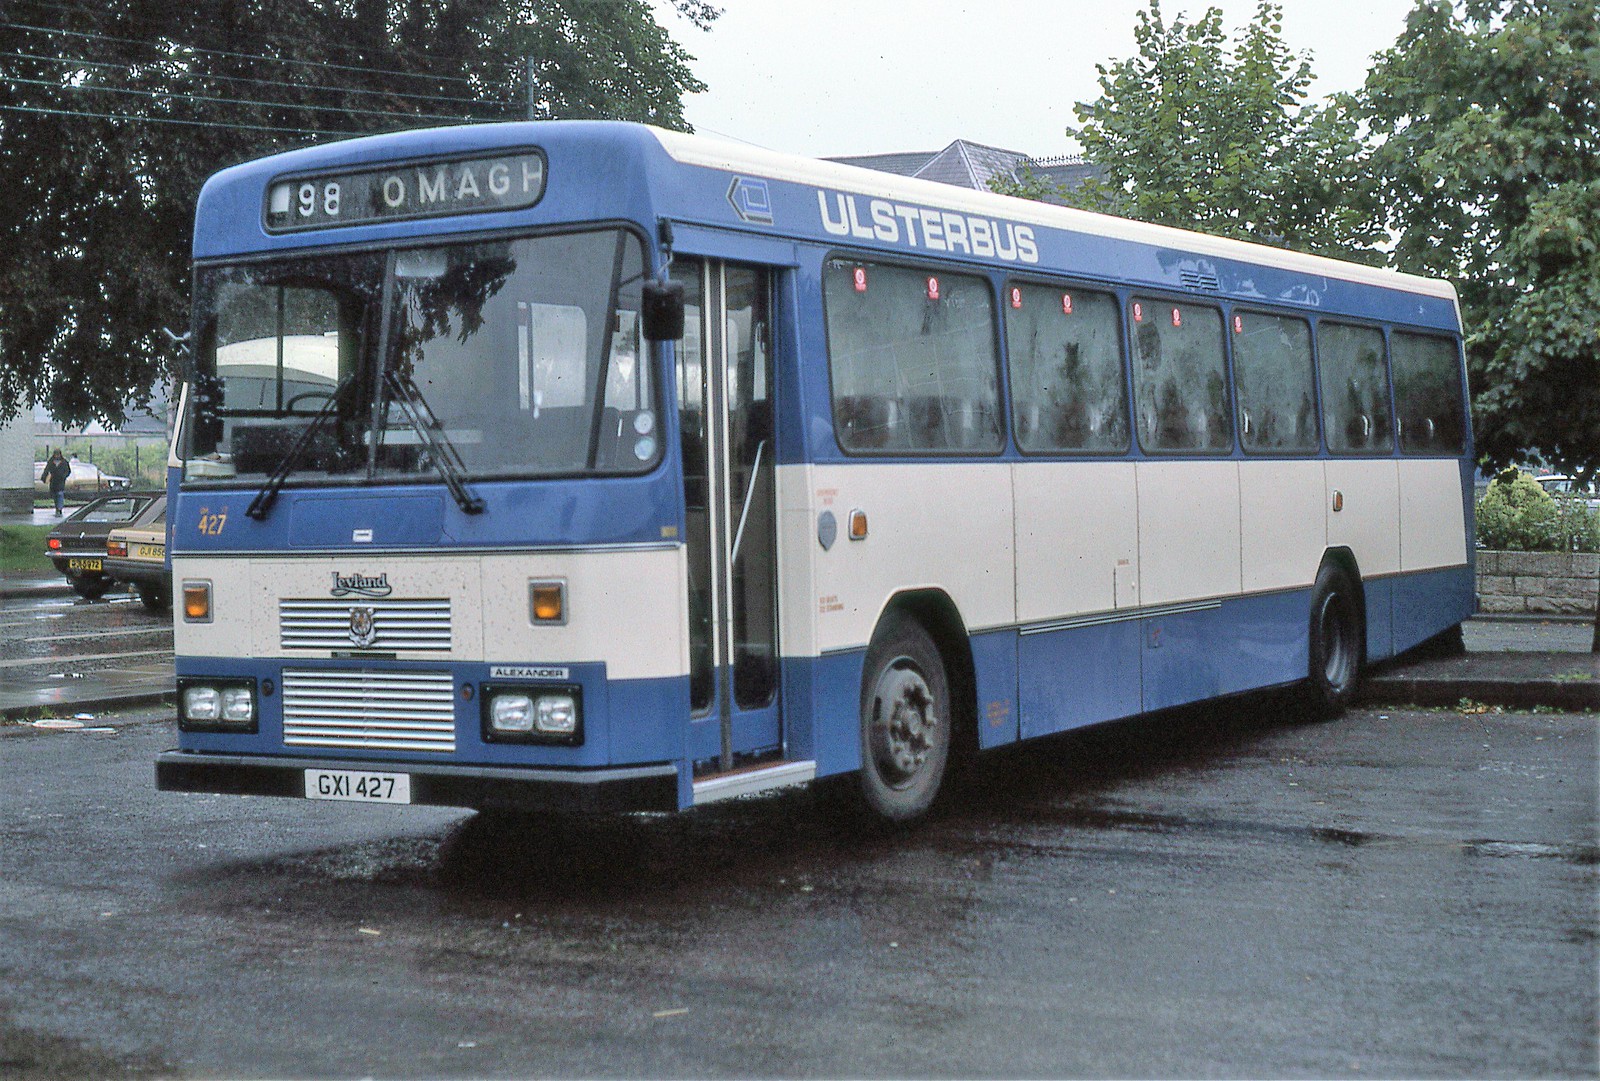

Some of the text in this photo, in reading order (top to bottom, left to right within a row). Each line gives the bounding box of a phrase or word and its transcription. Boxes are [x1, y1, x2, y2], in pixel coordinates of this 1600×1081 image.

[298, 162, 543, 217] 98 OMAGH
[817, 190, 1038, 263] ULSTERBUS
[198, 514, 227, 535] 427
[330, 571, 392, 597] Leyland
[495, 668, 563, 677] ALEXANDER
[318, 775, 395, 798] GXI 427
